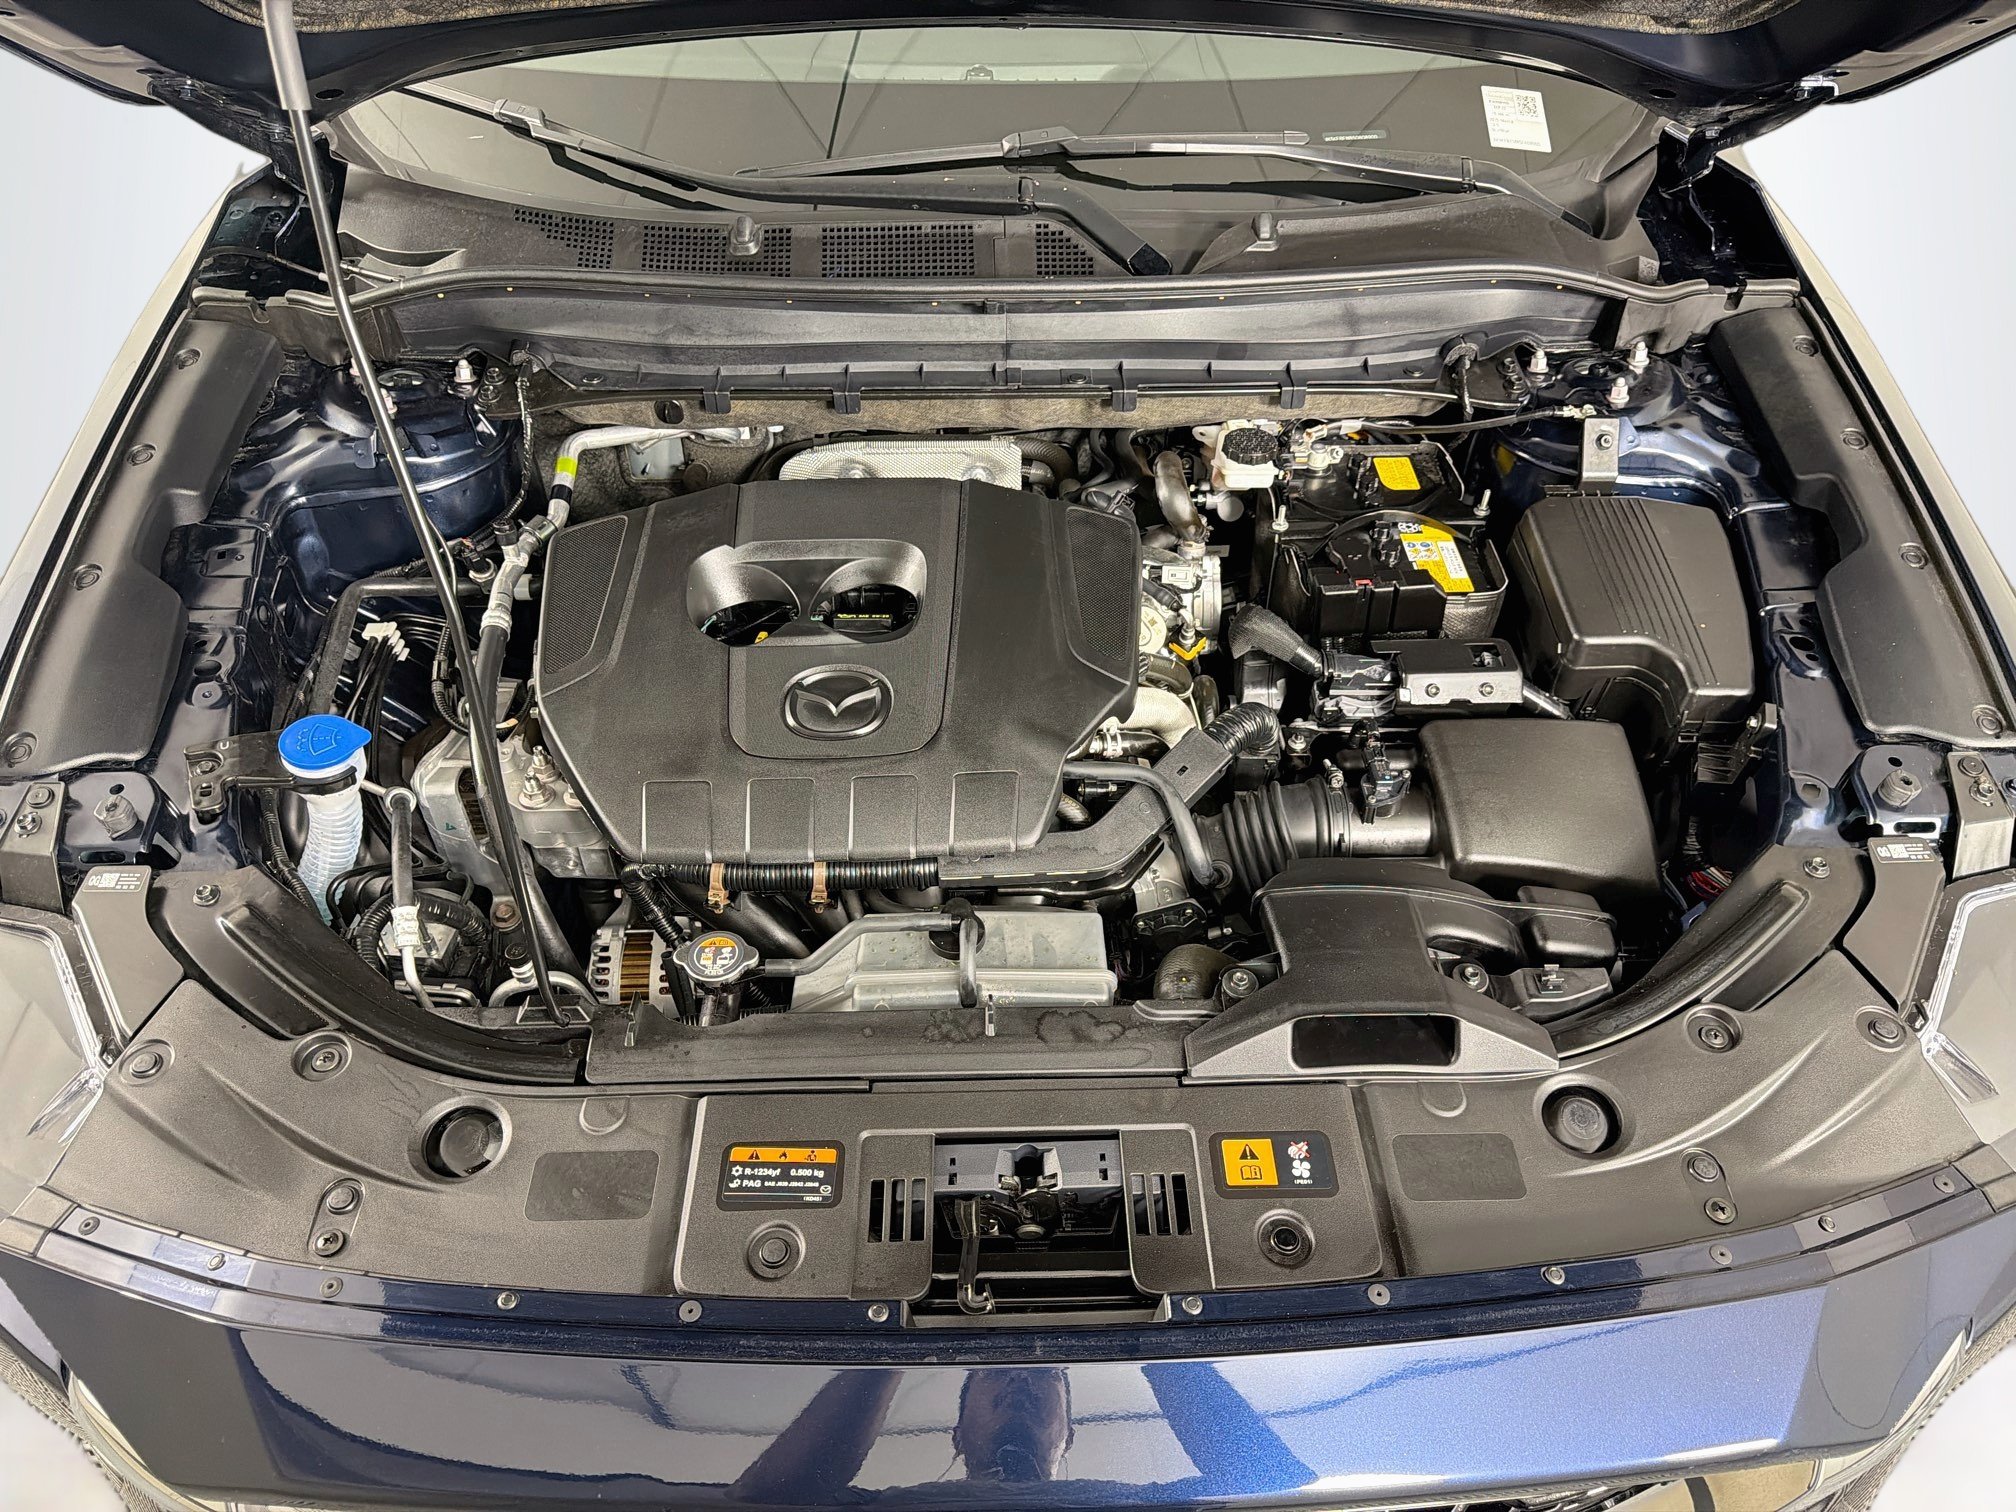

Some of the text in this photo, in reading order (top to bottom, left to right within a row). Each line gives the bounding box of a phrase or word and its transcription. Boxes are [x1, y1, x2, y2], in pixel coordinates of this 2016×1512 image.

[744, 1167, 825, 1179] R-1234yf 0.500 kg
[742, 1179, 762, 1188] PAG
